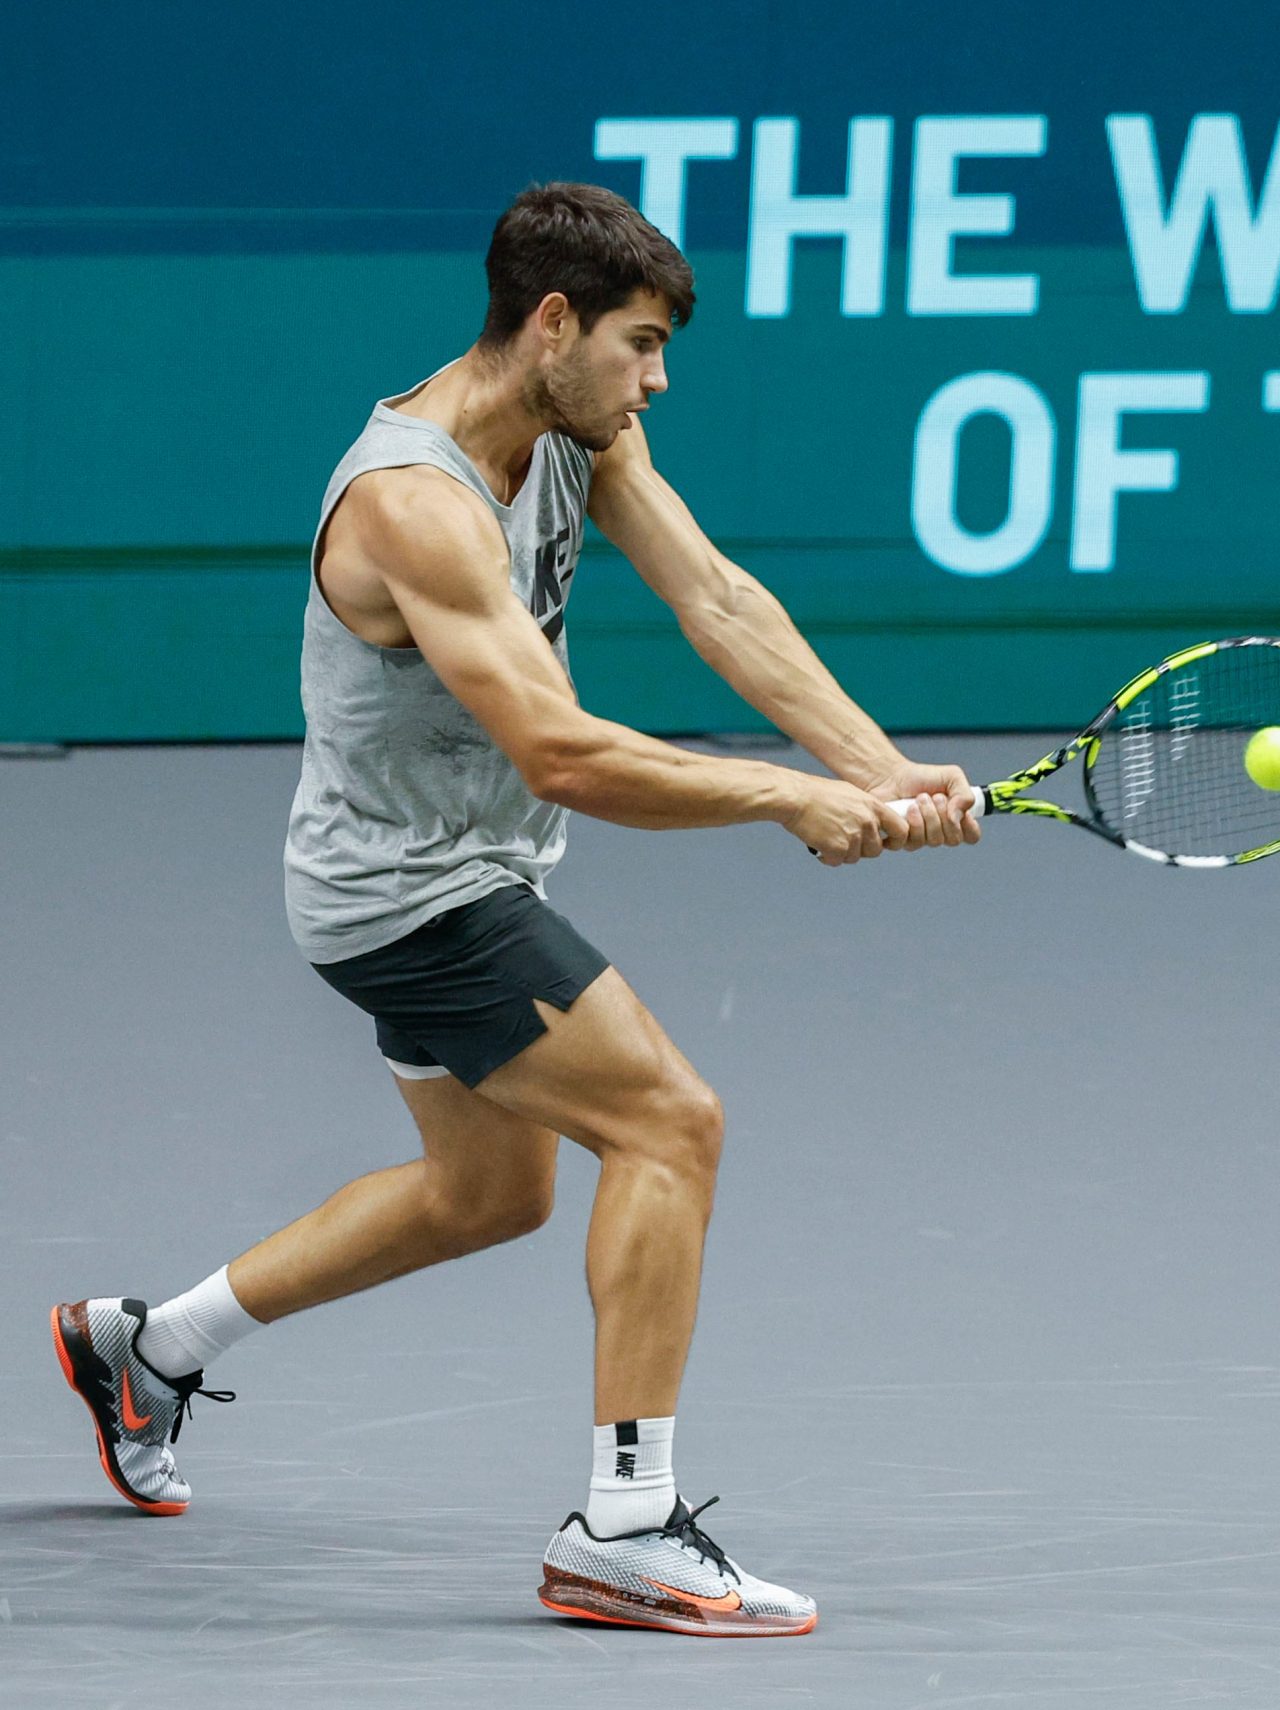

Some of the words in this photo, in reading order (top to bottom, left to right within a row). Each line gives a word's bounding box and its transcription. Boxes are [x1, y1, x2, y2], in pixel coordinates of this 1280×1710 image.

[594, 116, 1047, 317] THE
[911, 370, 1209, 576] OF
[616, 1451, 636, 1479] NIKE
